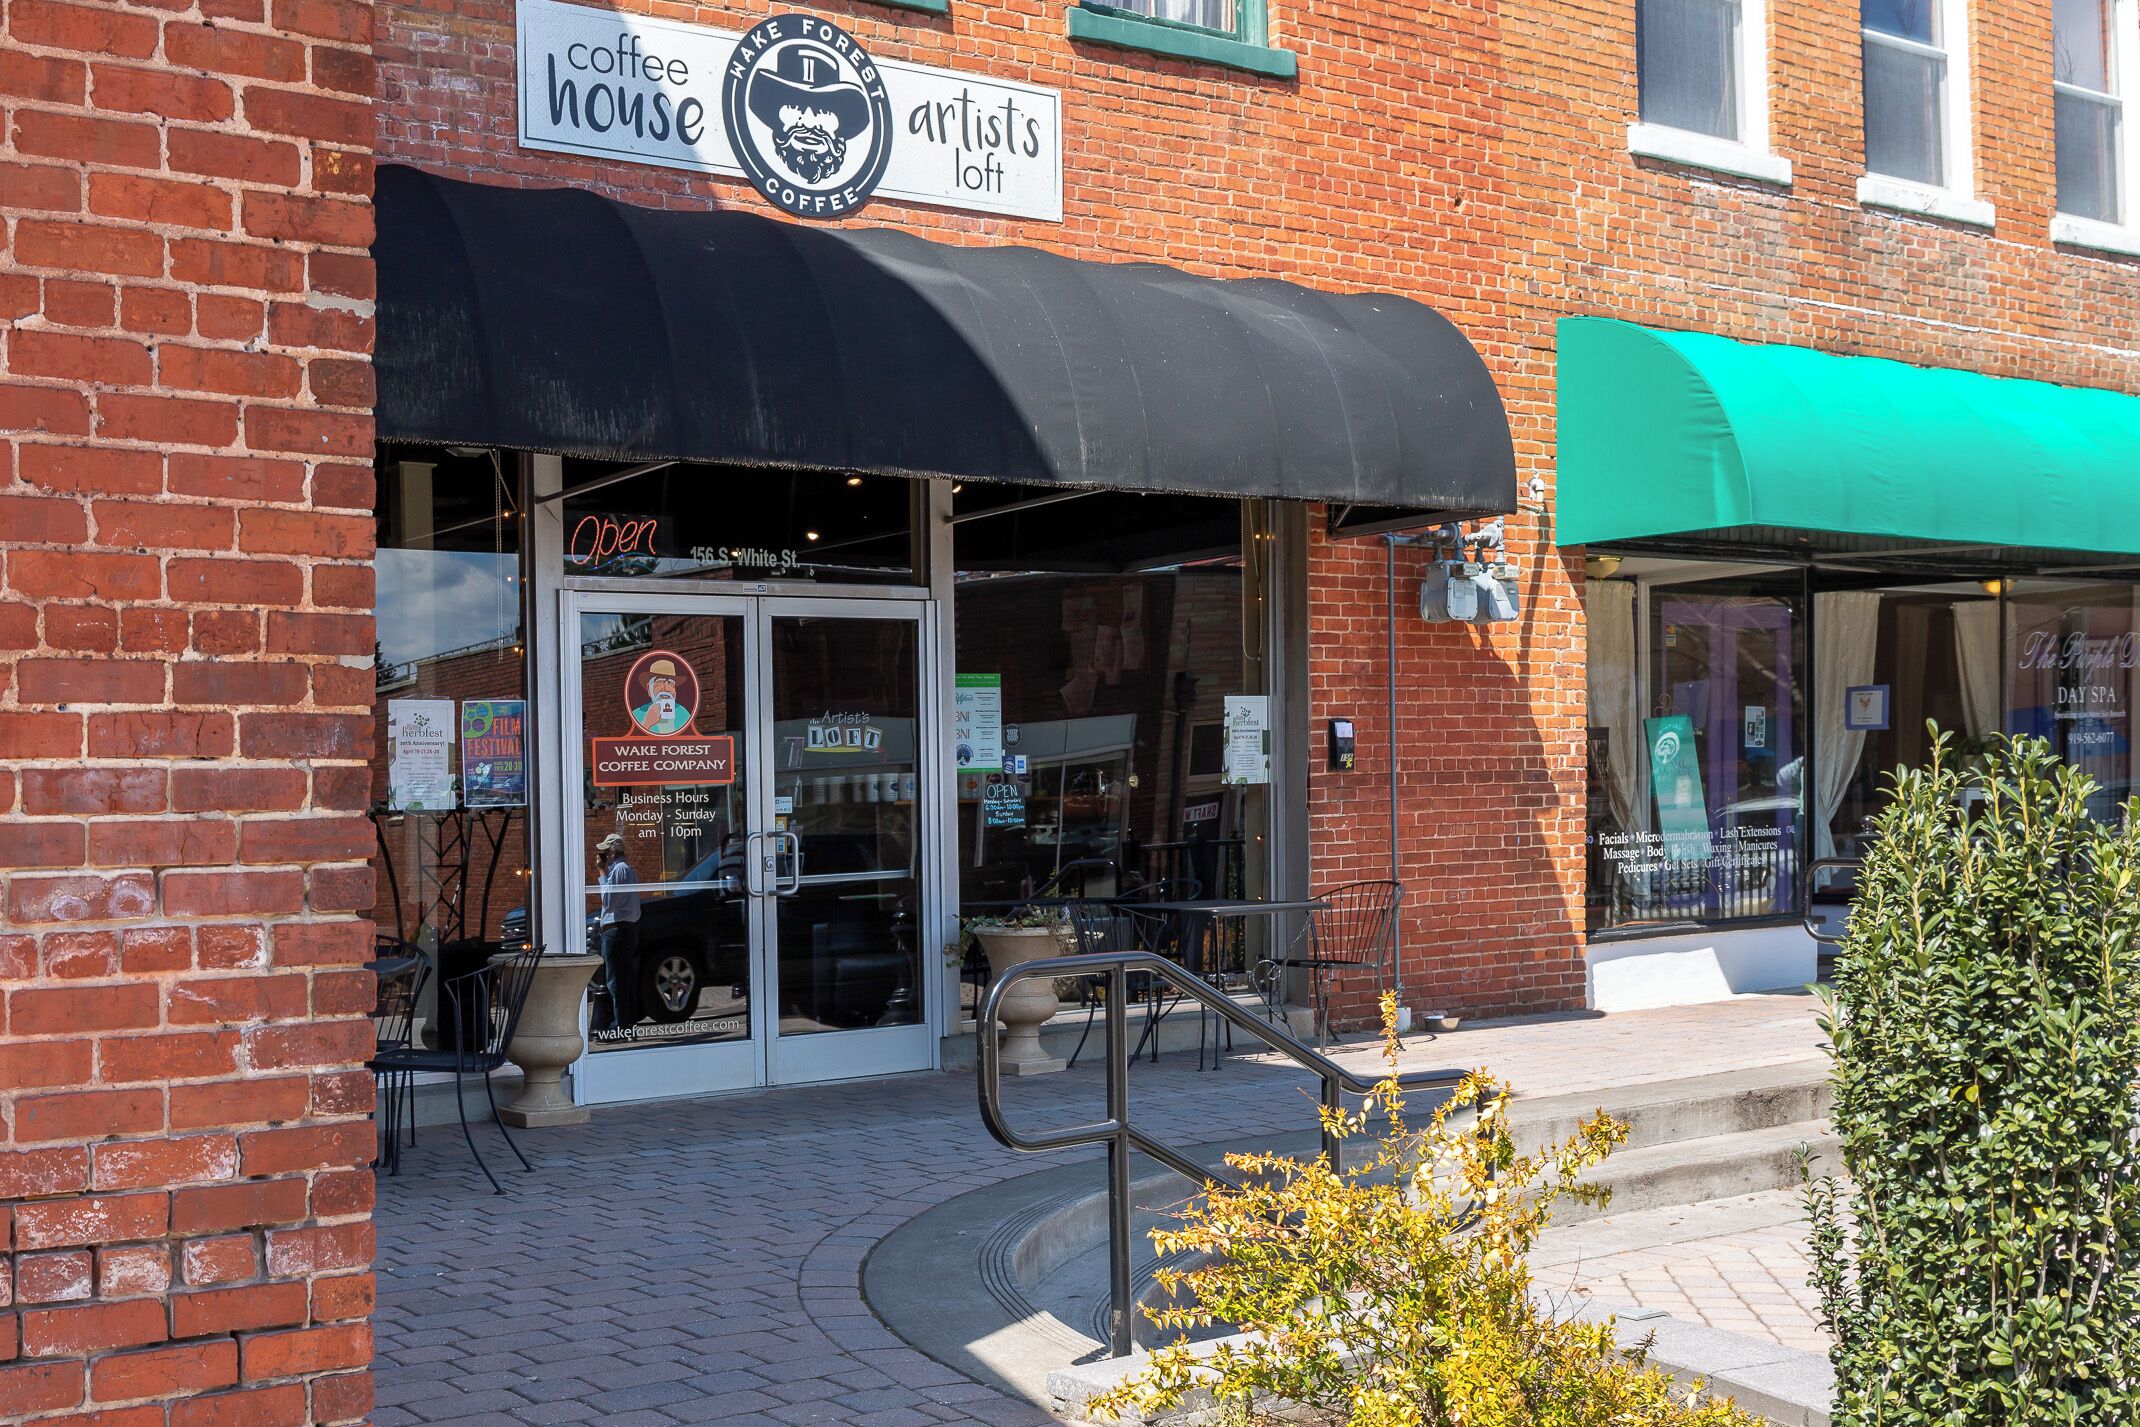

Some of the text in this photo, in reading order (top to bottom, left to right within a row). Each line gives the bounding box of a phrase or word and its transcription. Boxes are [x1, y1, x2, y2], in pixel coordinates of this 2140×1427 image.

[568, 32, 689, 87] coffee
[731, 18, 886, 100] WAKE FOREST
[547, 52, 705, 147] house
[908, 87, 1042, 159] artist's
[954, 147, 1005, 194] loft
[765, 178, 860, 211] COFFEE
[571, 515, 658, 566] Open
[690, 545, 801, 568] 156 S. White St.
[2019, 631, 2057, 669] The
[2057, 686, 2117, 704] DAY SPA
[493, 718, 521, 736] FILM
[821, 710, 870, 724] Artist's
[402, 726, 443, 738] herbfest
[810, 728, 881, 748] LOFT
[467, 737, 521, 757] FESTIVAL
[614, 744, 711, 756] WAKE FOREST
[599, 759, 727, 772] COFFEE COMPANY
[622, 791, 709, 804] Business Hours
[986, 783, 1018, 799] OPEN
[615, 810, 663, 823] Monday
[675, 809, 716, 822] Sunday
[638, 828, 656, 838] am
[670, 826, 702, 838] 10pm
[1599, 825, 1781, 845] Facials Microdermabrasion Lash Extensions
[1603, 846, 1640, 860] Massage
[1647, 845, 1668, 859] Body
[1702, 842, 1732, 857] Waxing
[1738, 838, 1778, 851] Manicures
[1618, 853, 1766, 875] Pedicures Gel Sets Gift Certificates
[598, 1019, 740, 1041] wakeforestcoffee.com
